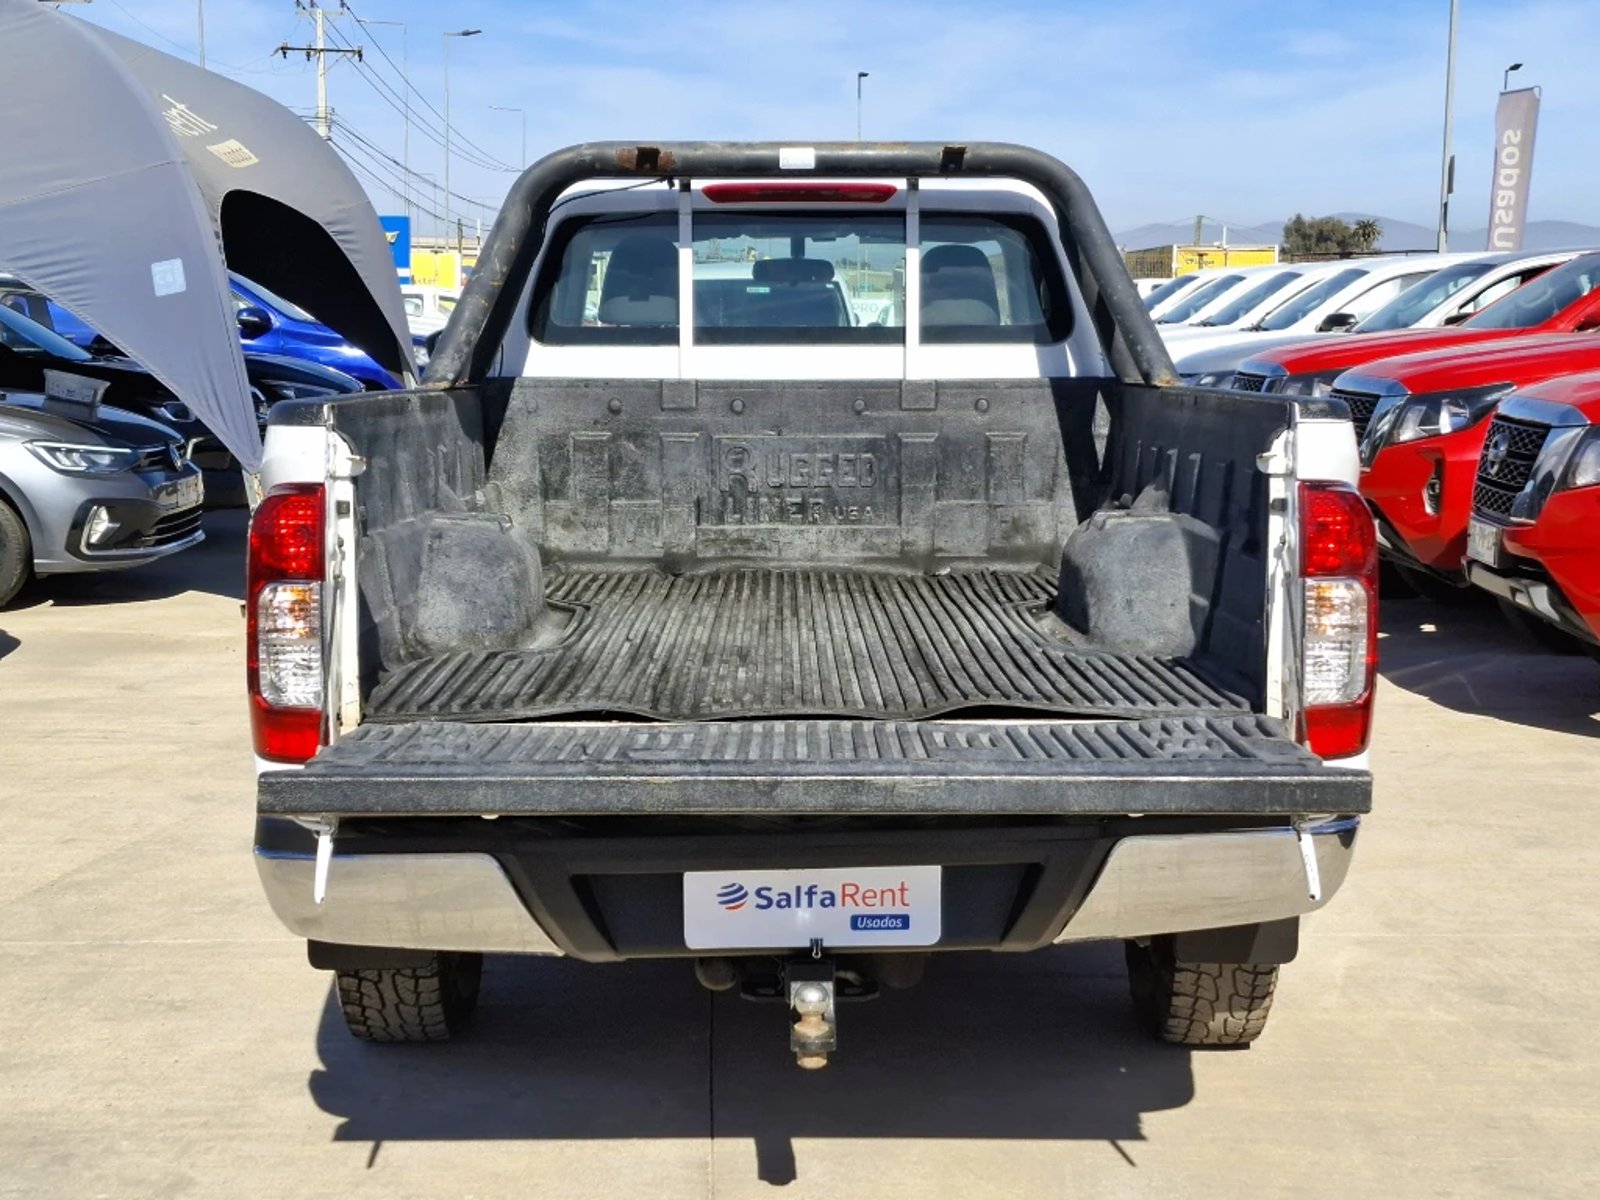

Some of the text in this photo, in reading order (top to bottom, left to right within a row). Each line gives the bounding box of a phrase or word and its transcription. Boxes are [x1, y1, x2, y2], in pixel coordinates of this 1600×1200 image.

[719, 446, 877, 493] RUGGED
[724, 497, 873, 525] LINER USA
[754, 881, 910, 910] SalfaRent
[856, 916, 903, 929] Usados
